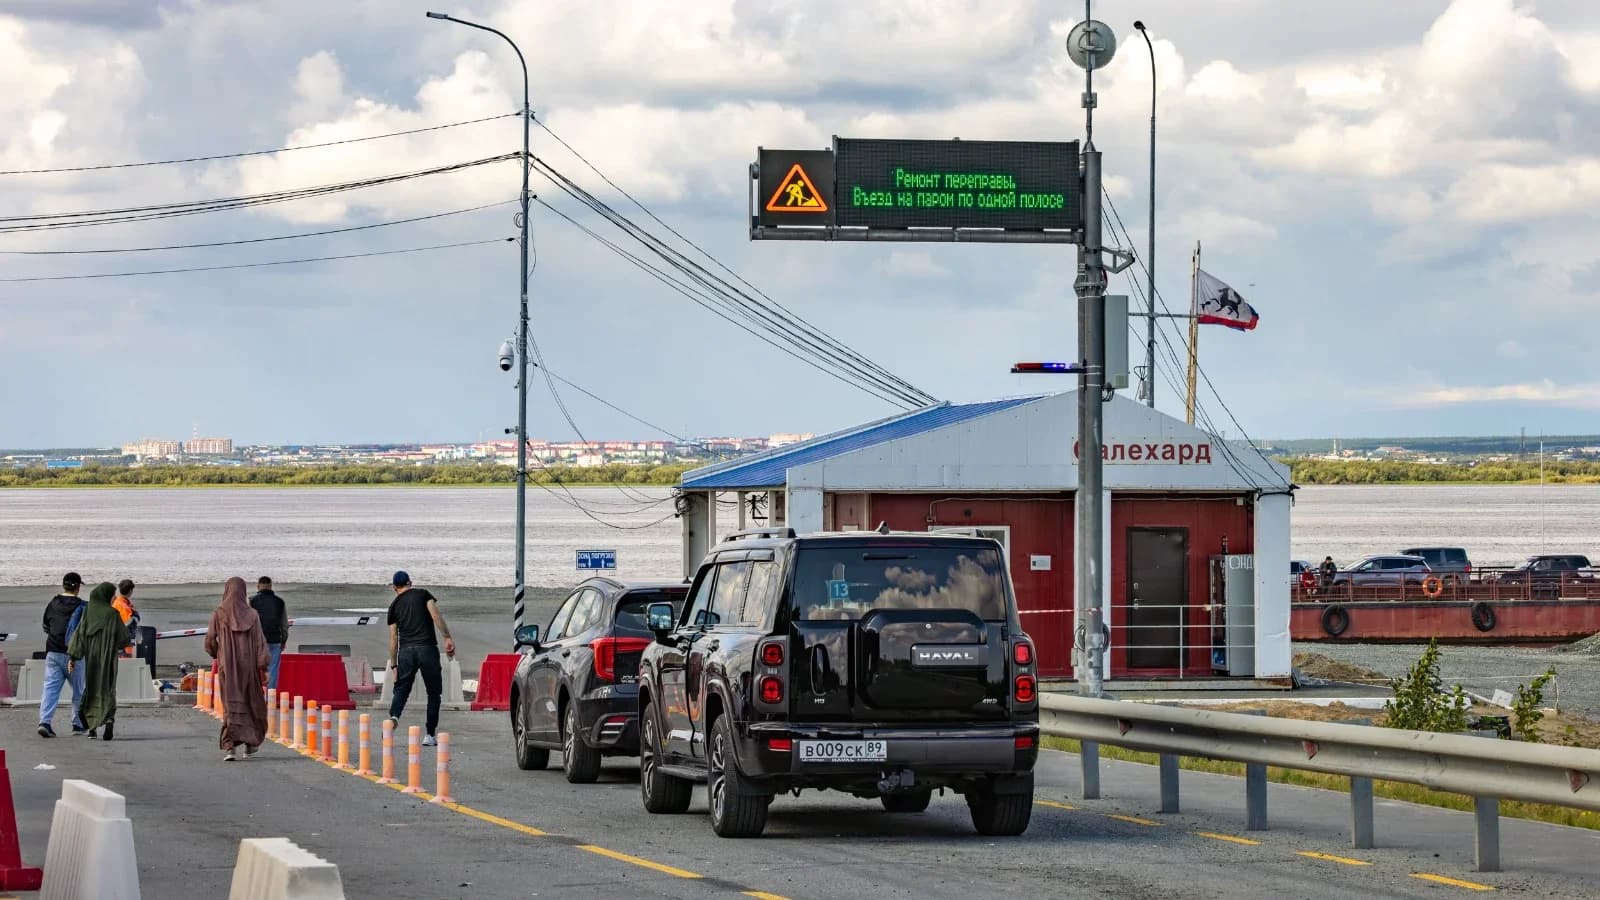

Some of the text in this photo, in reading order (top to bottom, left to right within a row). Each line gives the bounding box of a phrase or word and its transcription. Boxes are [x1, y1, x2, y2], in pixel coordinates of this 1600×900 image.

[896, 168, 941, 188] Ремонт
[853, 187, 1064, 209] Въезд на паром по одной полосе
[833, 583, 849, 597] 13
[919, 652, 974, 660] HAVAL
